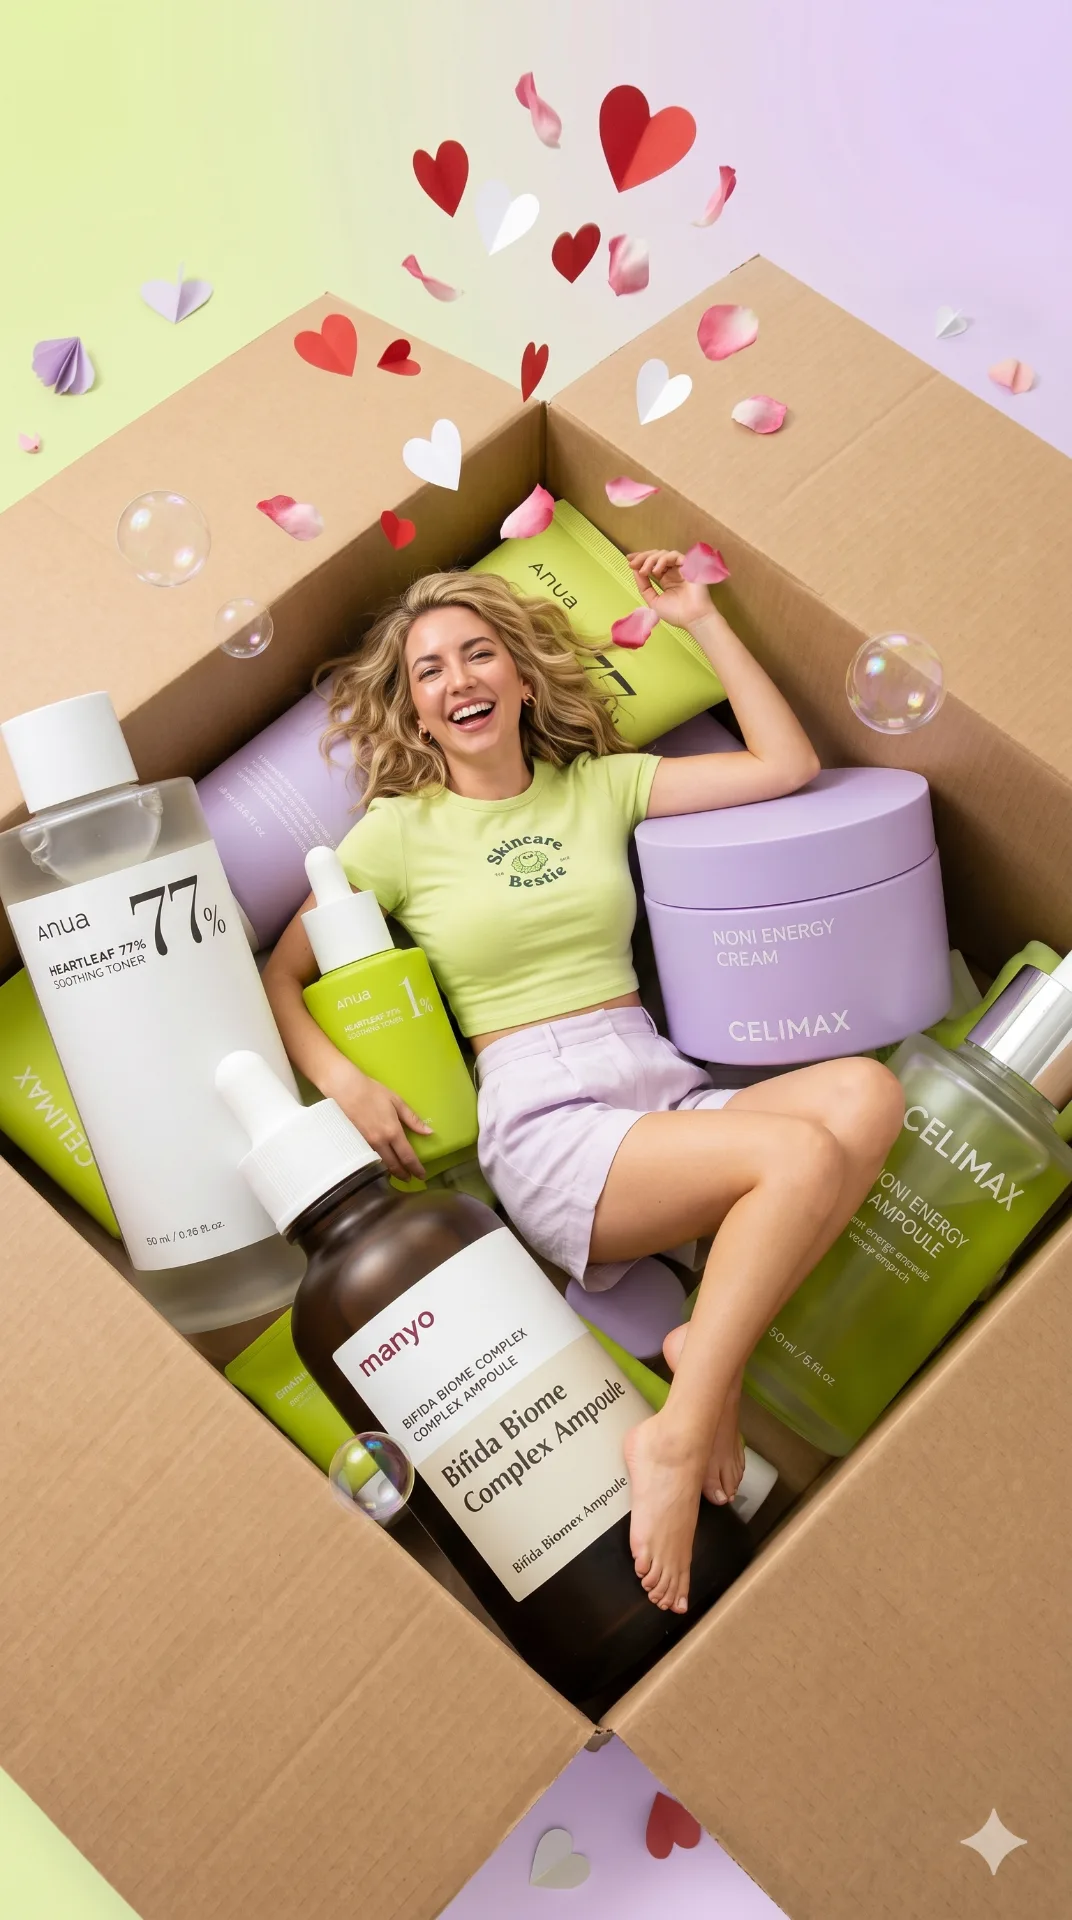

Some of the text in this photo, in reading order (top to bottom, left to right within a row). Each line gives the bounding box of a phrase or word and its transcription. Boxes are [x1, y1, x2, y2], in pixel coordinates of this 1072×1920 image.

[528, 562, 578, 610] Anua
[486, 835, 563, 866] Skincare
[508, 866, 567, 888] Bestie
[37, 912, 91, 942] Anua
[712, 916, 837, 947] NONI ENERGY
[49, 938, 147, 977] HEARTLEAF 77%
[53, 953, 147, 990] SOOTHING TONER
[716, 949, 779, 968] CREAM
[336, 989, 372, 1012] Anua
[728, 1008, 851, 1043] CELIMAX
[12, 1064, 95, 1168] CELIMAX
[902, 1104, 1026, 1213] CELIMAX
[146, 1236, 158, 1246] 50
[159, 1233, 171, 1244] ml
[866, 1192, 945, 1259] AMPOULE
[908, 1195, 971, 1249] ENERGY
[358, 1310, 435, 1378] manyo
[768, 1326, 785, 1343] 50
[782, 1340, 798, 1354] ml
[822, 1373, 836, 1387] oz
[402, 1327, 528, 1430] BIFIDA BIOME COMPLEX
[413, 1354, 519, 1442] COMPLEX AMPOULE
[440, 1384, 568, 1488] Bifida Biome
[463, 1379, 626, 1513] Complex Ampoule
[511, 1476, 629, 1574] Bifida Biomex Ampoule
